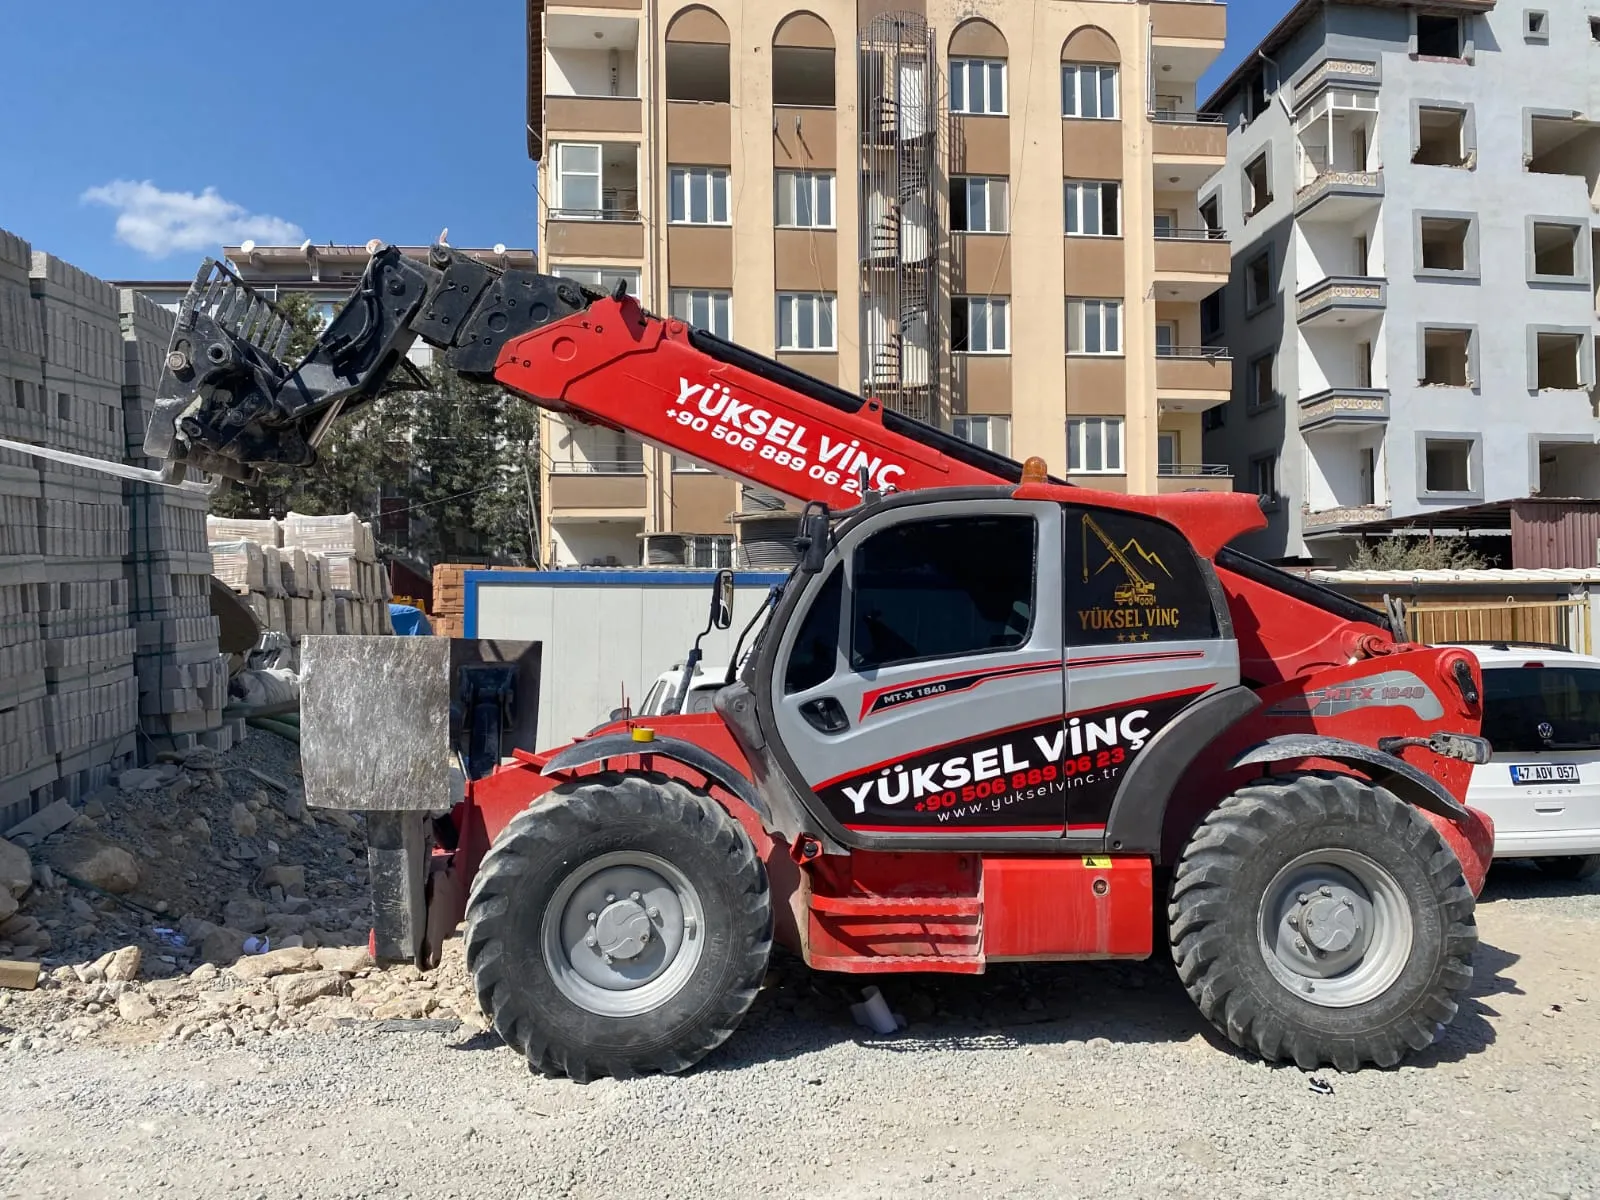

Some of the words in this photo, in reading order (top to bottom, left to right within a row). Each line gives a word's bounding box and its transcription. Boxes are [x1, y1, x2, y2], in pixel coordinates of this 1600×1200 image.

[666, 408, 709, 432] +90
[711, 425, 758, 451] 506
[759, 445, 807, 472] 889
[808, 465, 841, 486] 06
[840, 478, 864, 498] 2
[676, 377, 807, 454] YÜKSEL
[818, 434, 906, 495] VİNÇ
[1078, 607, 1143, 630] YÜKSEL
[1145, 605, 1180, 628] VİNÇ
[883, 690, 914, 704] MT-X
[917, 684, 947, 697] 1840
[1381, 686, 1425, 700] 1840
[841, 764, 1030, 815] YÜKSEL
[1033, 709, 1151, 762] VİNÇ
[914, 791, 957, 813] +90
[961, 777, 1007, 802] 506
[1011, 764, 1057, 790] 889
[1064, 758, 1092, 777] 06
[1096, 746, 1126, 769] 23
[1518, 767, 1530, 780] 47
[1556, 766, 1574, 779] 057
[937, 766, 1119, 823] www.yukselvinc.tr
